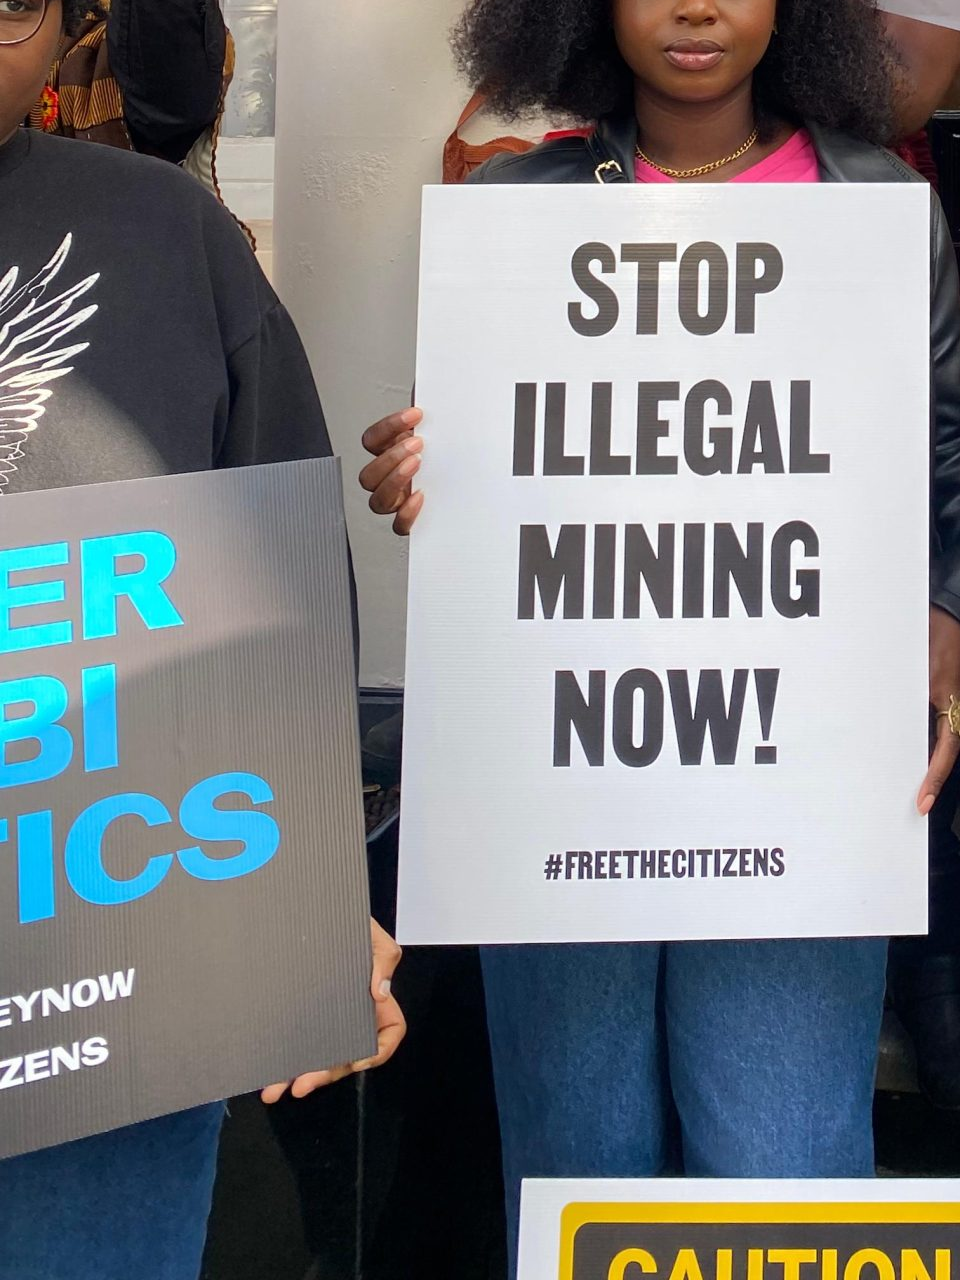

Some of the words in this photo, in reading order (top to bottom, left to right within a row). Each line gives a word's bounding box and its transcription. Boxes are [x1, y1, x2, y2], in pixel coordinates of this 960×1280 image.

[567, 241, 784, 338] STOP
[512, 378, 831, 477] ILLEGAL
[517, 520, 821, 621] MINING
[553, 667, 781, 769] NOW!
[0, 771, 281, 925] ICS
[544, 846, 786, 882] #FREETHECITIZENS
